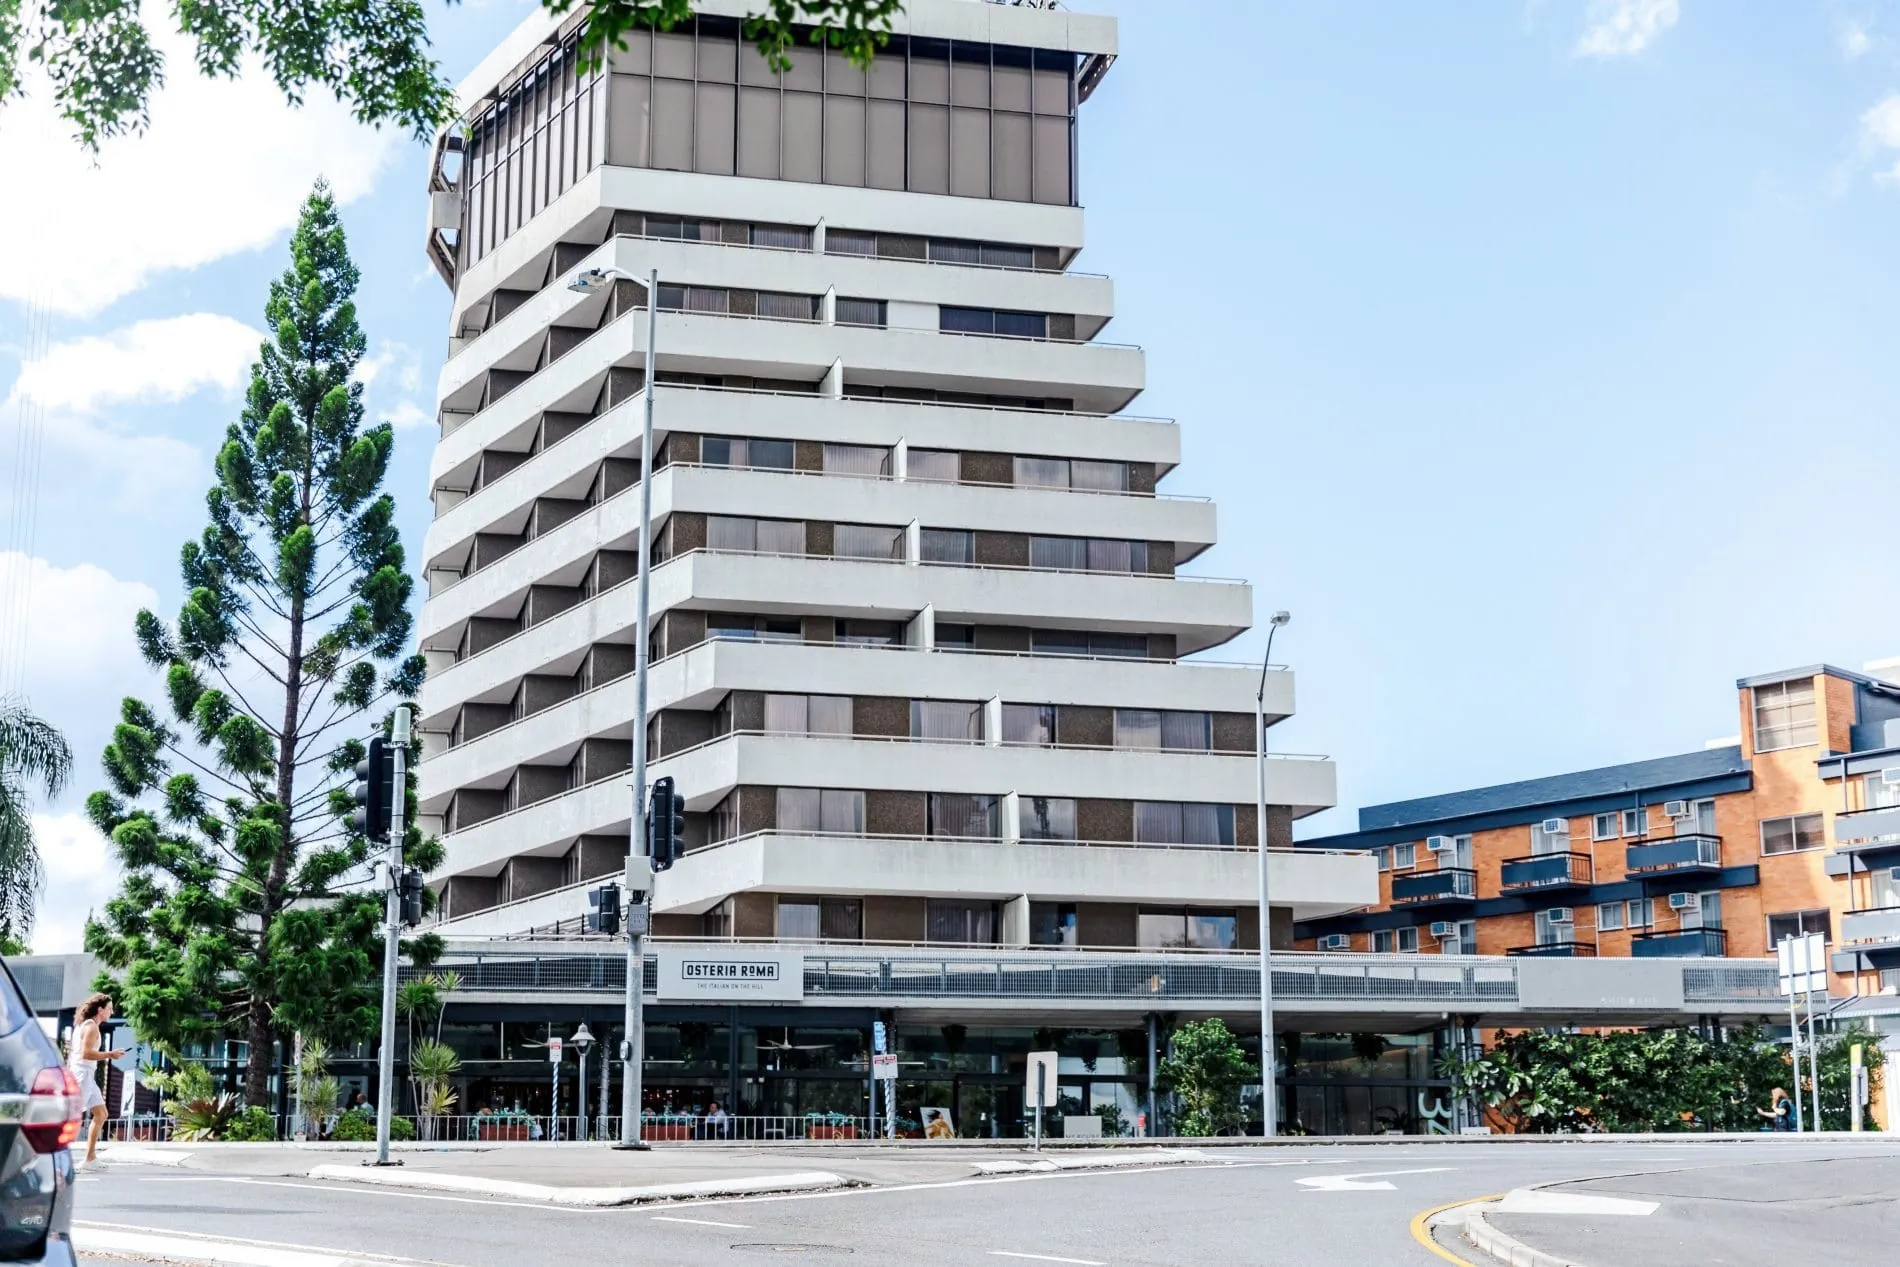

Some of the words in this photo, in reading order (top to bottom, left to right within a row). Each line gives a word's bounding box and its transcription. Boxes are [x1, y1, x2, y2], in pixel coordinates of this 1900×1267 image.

[687, 965, 737, 976] OSTERIA
[741, 965, 774, 977] ROMA
[20, 1215, 43, 1225] 4WD
